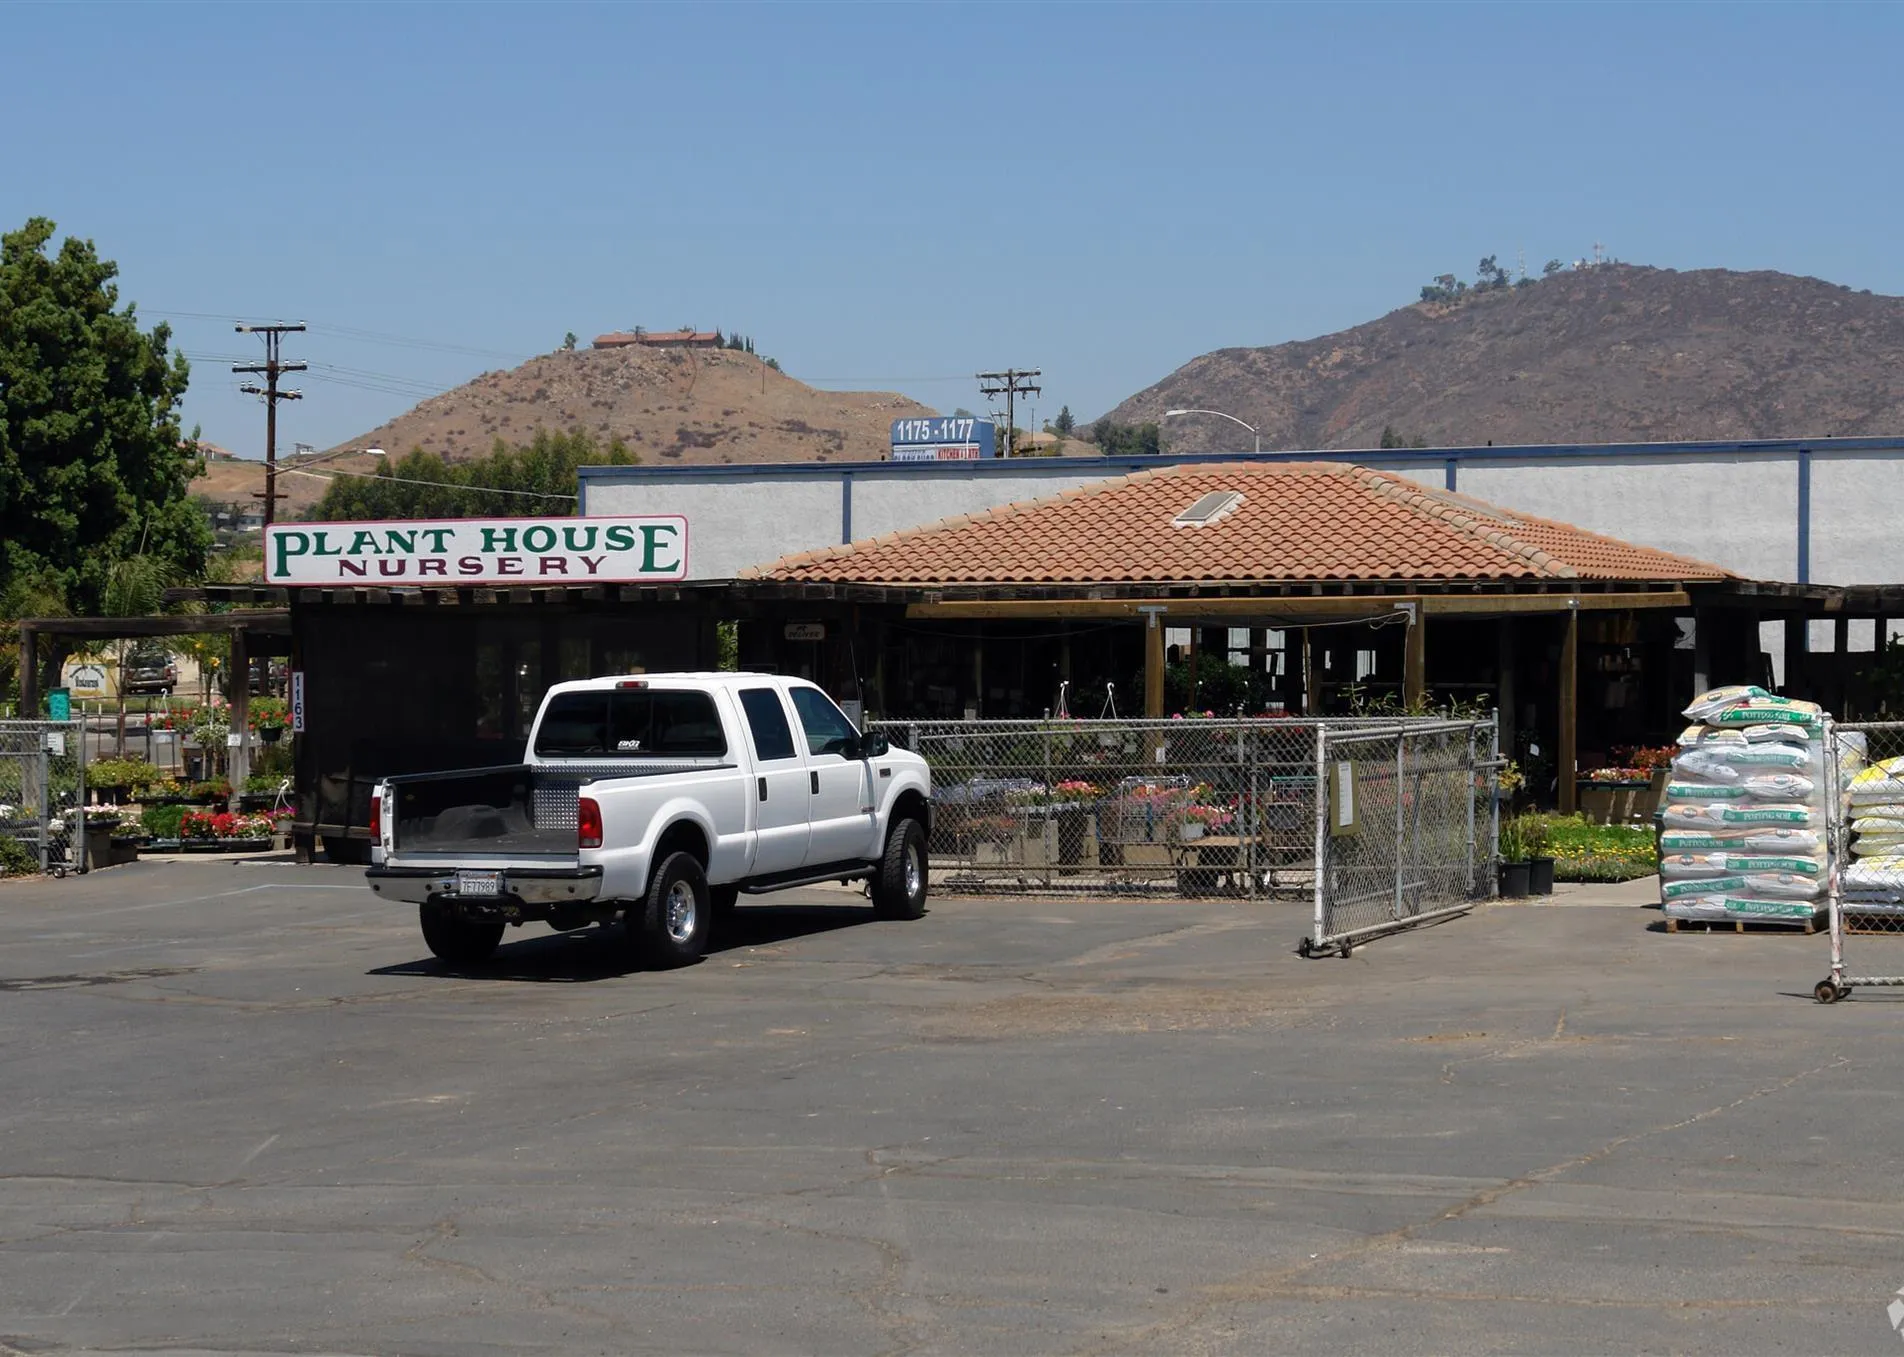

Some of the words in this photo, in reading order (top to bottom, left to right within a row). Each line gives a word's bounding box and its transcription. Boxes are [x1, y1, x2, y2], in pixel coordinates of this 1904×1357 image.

[897, 420, 930, 441] 1175
[941, 418, 974, 440] 1177
[272, 528, 456, 577] PLANT
[480, 525, 680, 573] HOUSE
[338, 555, 608, 577] NURSERY
[294, 674, 303, 729] 1163
